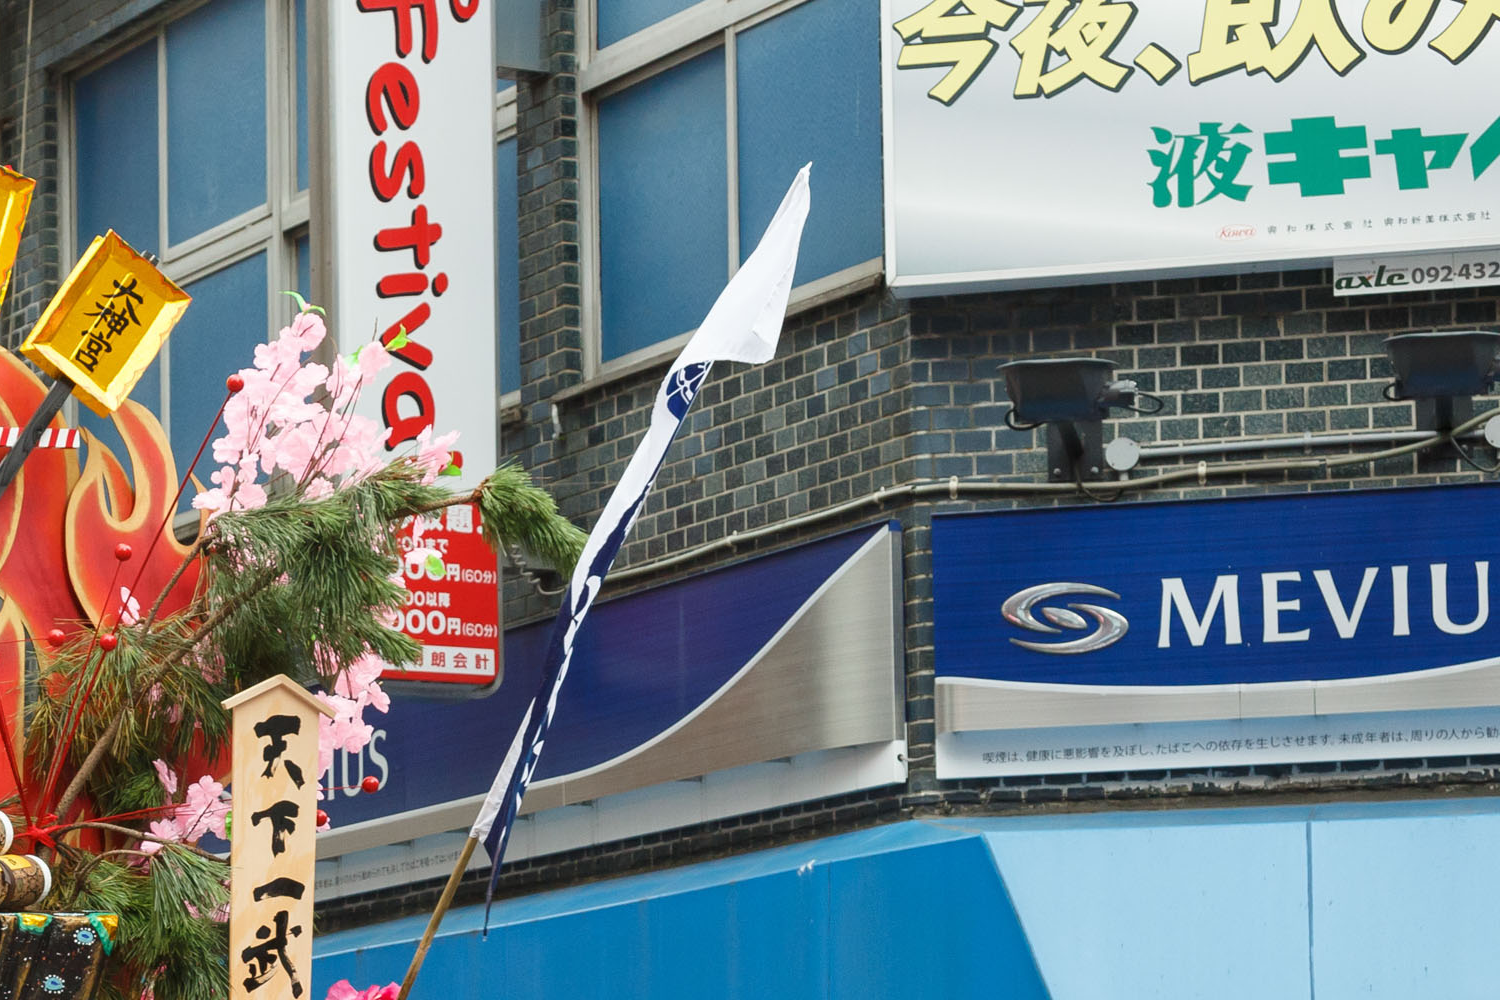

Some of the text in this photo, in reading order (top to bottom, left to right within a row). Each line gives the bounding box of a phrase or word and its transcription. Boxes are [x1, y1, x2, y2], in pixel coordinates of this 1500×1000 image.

[1146, 116, 1500, 208] 液キャ
[356, 0, 463, 476] Festiva
[1335, 265, 1410, 290] axle
[75, 278, 143, 373] 大神宮
[1158, 561, 1490, 648] MEVIU
